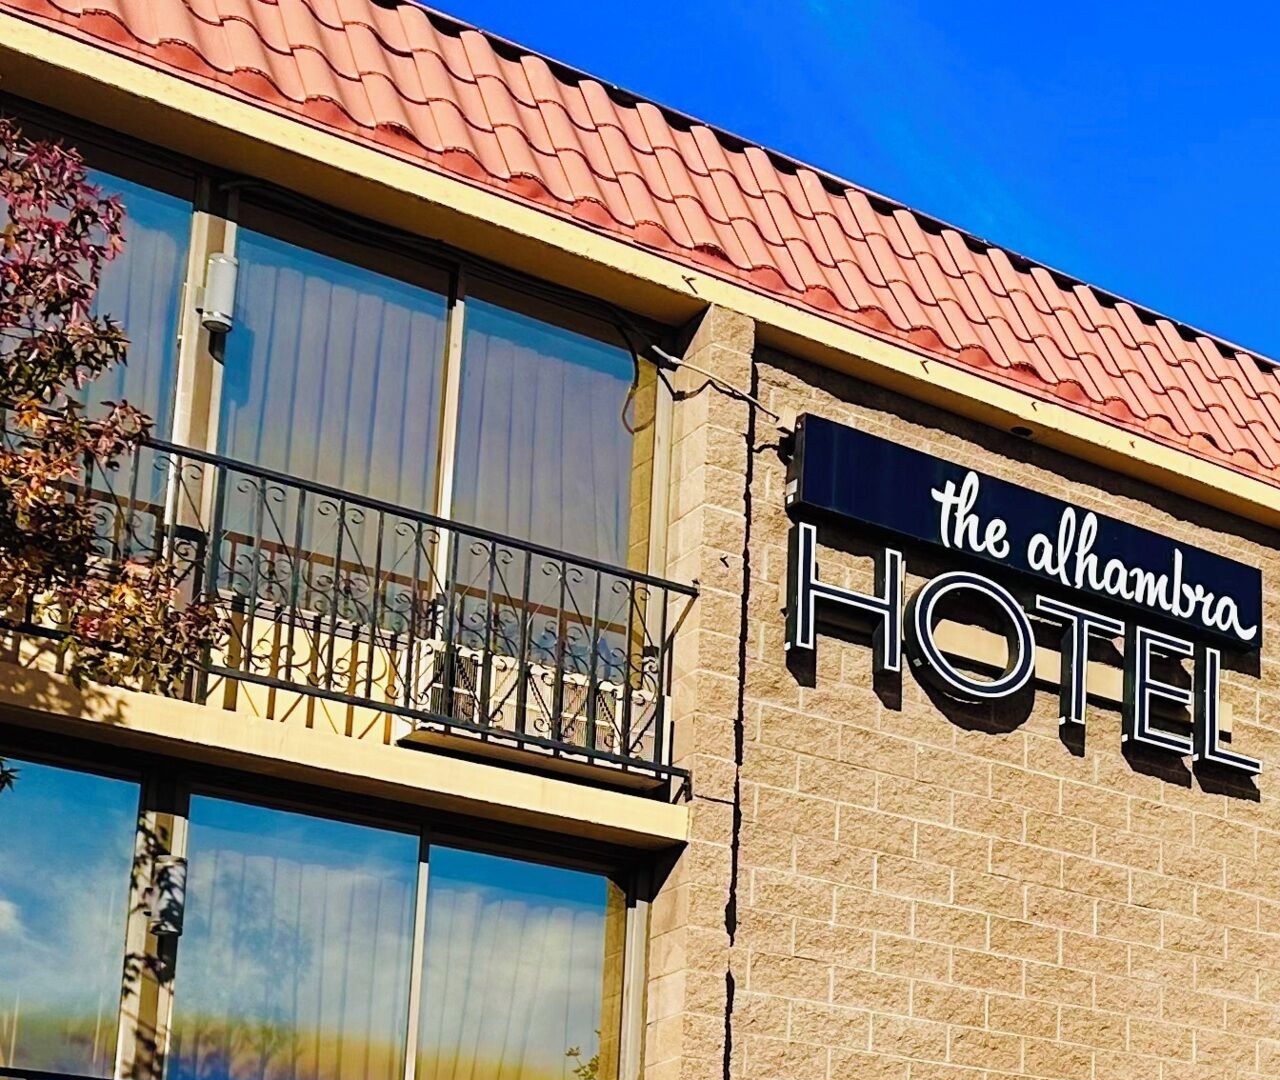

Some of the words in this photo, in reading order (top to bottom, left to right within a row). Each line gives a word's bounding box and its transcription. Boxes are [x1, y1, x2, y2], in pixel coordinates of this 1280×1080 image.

[796, 521, 1264, 775] HOTEL
[930, 470, 1010, 559] the
[1027, 506, 1258, 641] alhambra
